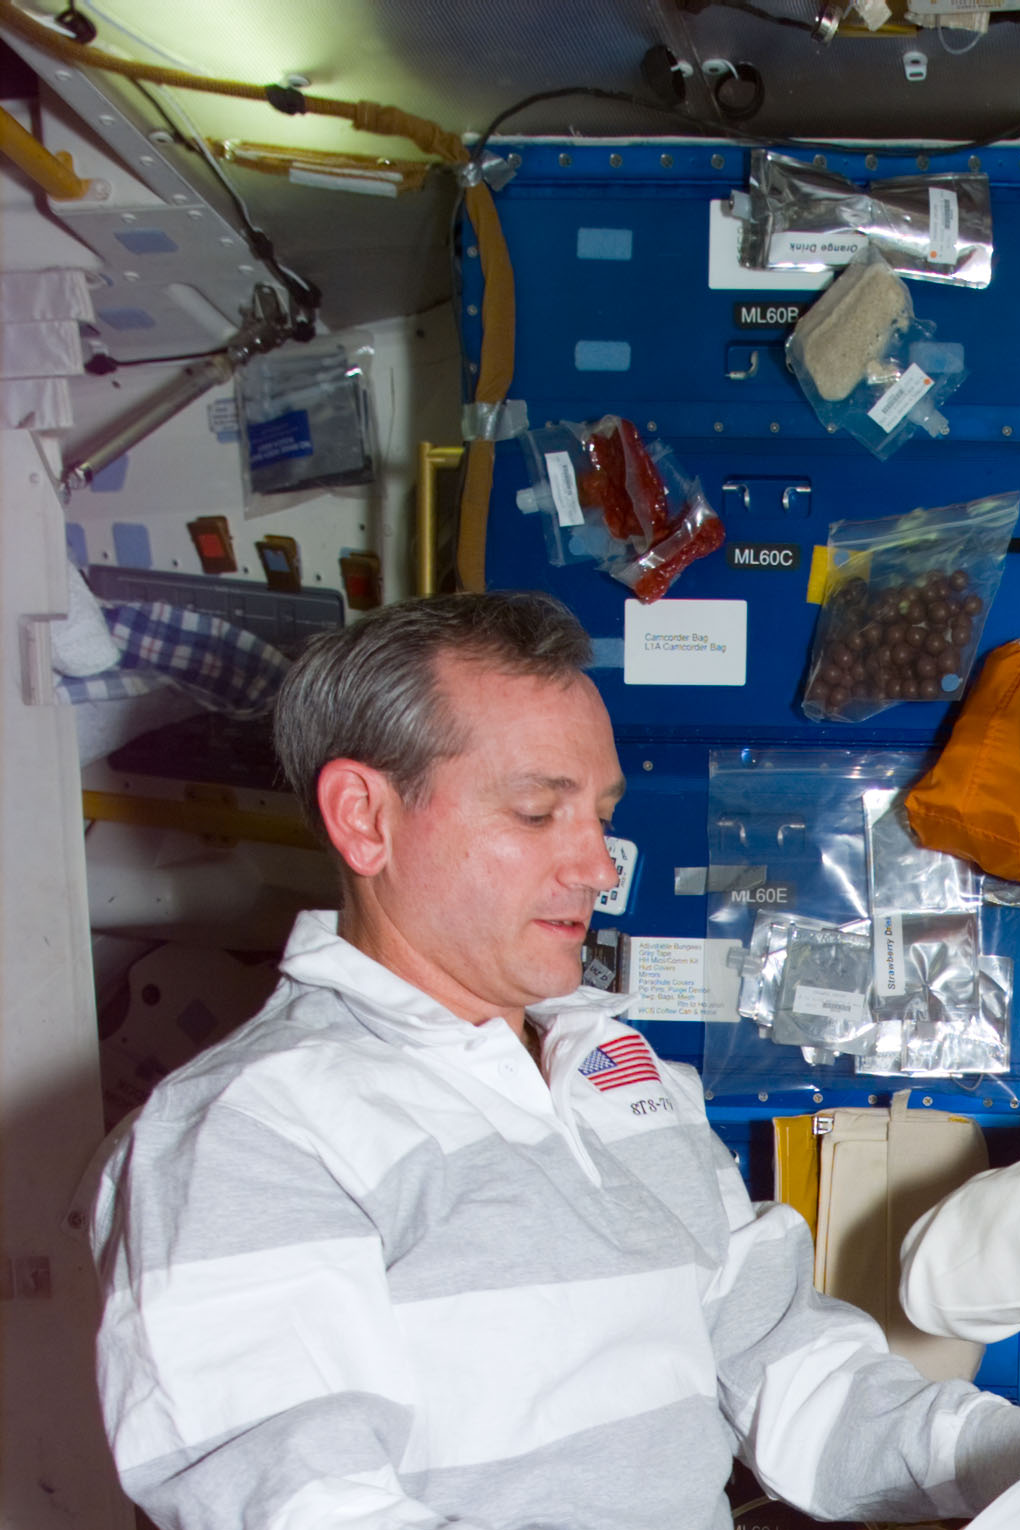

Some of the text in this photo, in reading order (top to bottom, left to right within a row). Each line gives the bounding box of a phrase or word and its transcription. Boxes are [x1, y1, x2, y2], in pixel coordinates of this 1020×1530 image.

[789, 242, 858, 253] Orange Drink
[734, 548, 793, 566] ML60C
[644, 632, 709, 644] Camcorder Bag
[662, 642, 707, 652] Camcorder
[709, 643, 727, 653] Bag
[731, 887, 788, 904] ML60E
[885, 939, 896, 990] Strawberry
